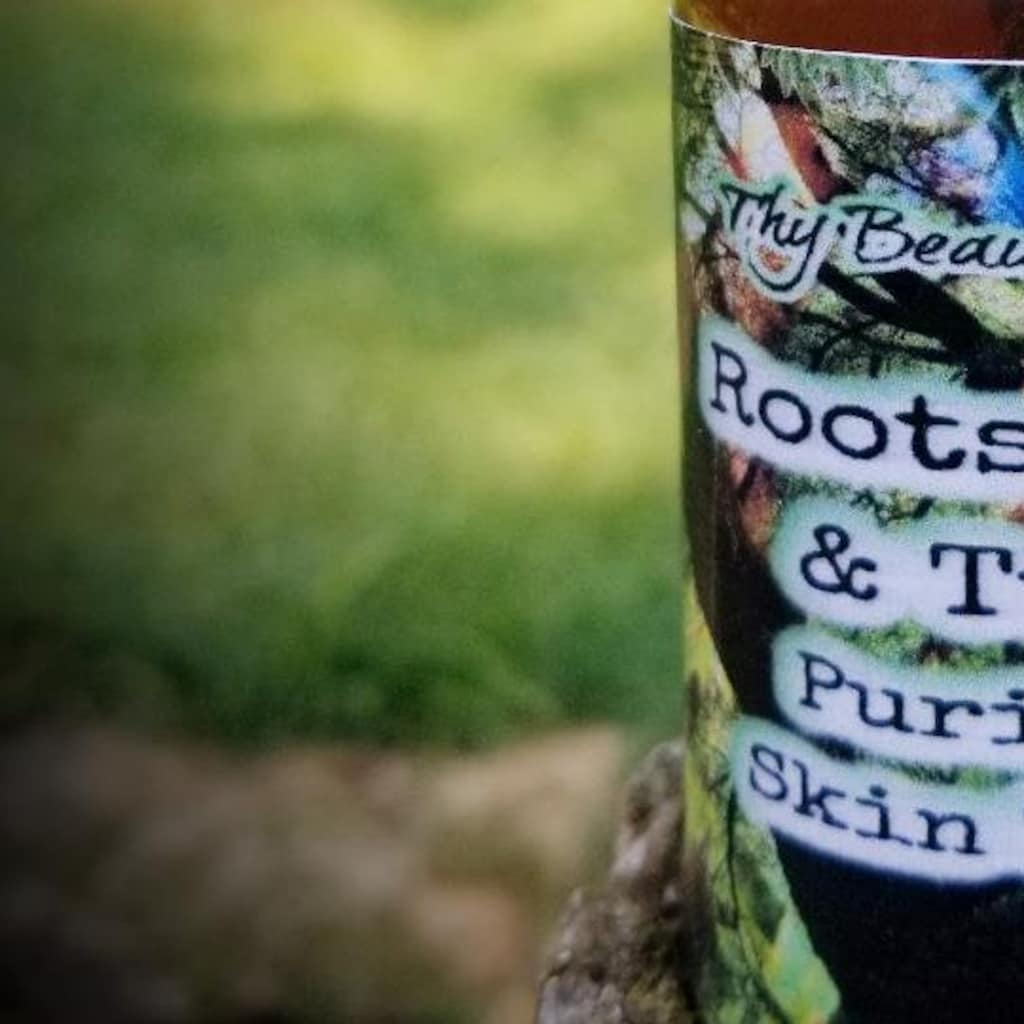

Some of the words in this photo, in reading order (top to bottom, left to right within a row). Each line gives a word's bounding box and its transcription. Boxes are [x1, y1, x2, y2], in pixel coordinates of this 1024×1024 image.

[720, 184, 825, 293] Thy
[800, 524, 879, 602] &
[748, 743, 988, 857] Skin
